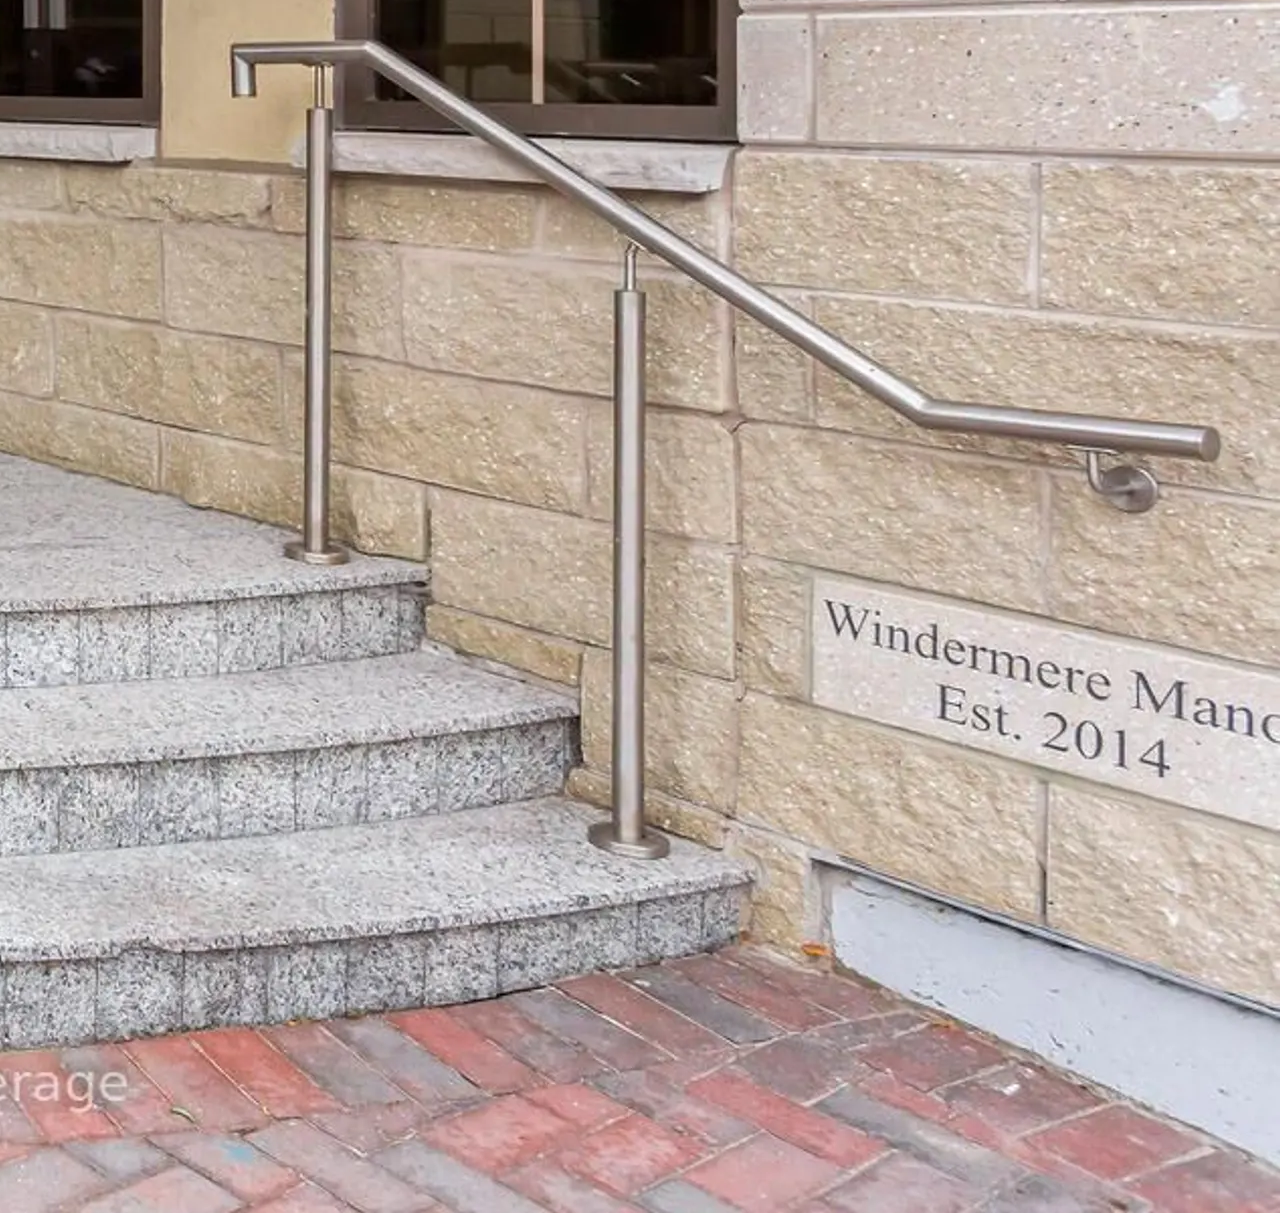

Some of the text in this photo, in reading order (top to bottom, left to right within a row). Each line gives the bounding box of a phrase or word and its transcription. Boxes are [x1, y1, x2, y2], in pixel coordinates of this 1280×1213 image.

[824, 599, 1112, 700] Windermere
[937, 683, 1171, 778] Est. 2014
